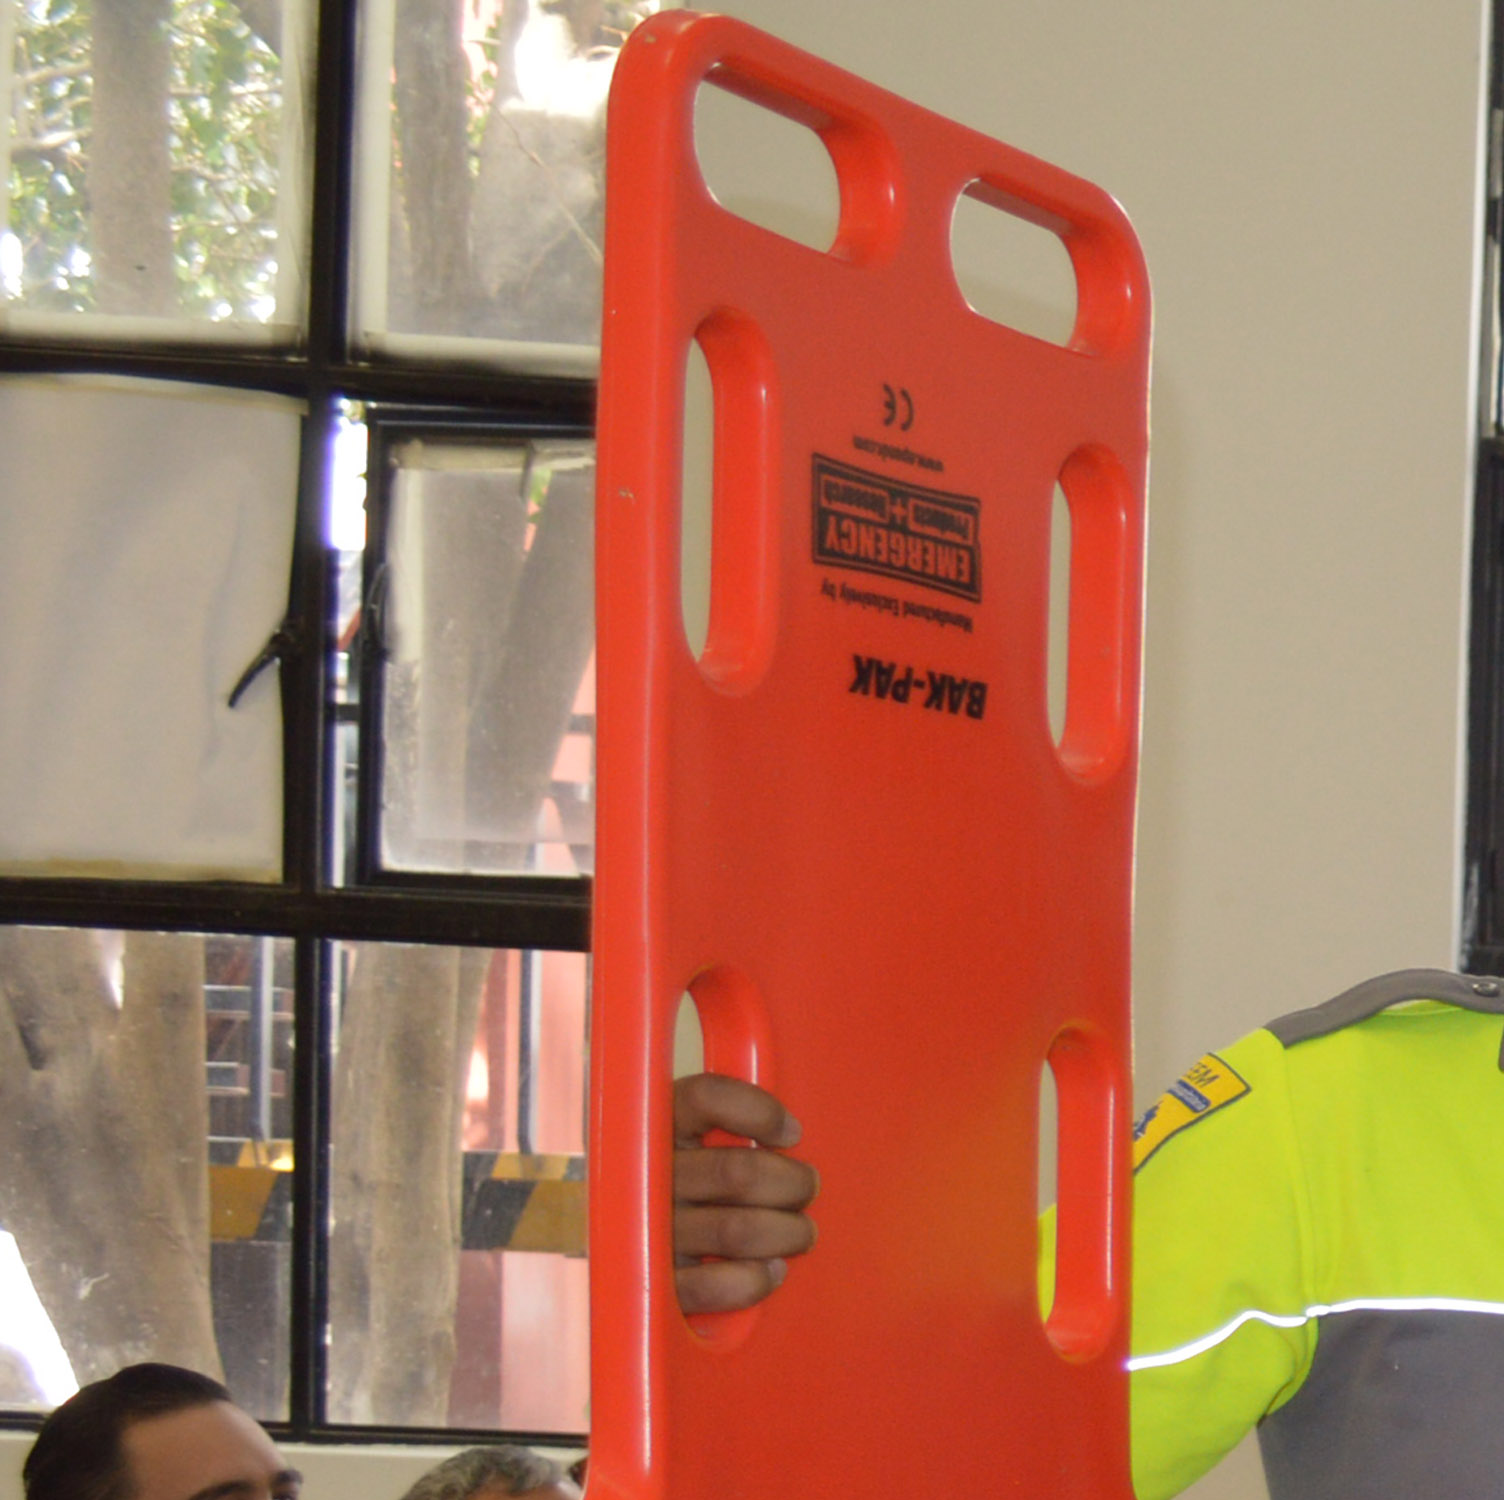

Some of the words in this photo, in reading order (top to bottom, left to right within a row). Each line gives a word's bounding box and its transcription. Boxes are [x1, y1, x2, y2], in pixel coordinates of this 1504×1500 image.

[823, 479, 887, 519] Research
[913, 504, 971, 540] Products
[825, 515, 971, 584] EMERGENCY
[820, 577, 837, 602] by
[840, 581, 900, 617] Exclusively
[902, 601, 974, 633] Manufactured
[849, 653, 988, 720] BAK-PAK
